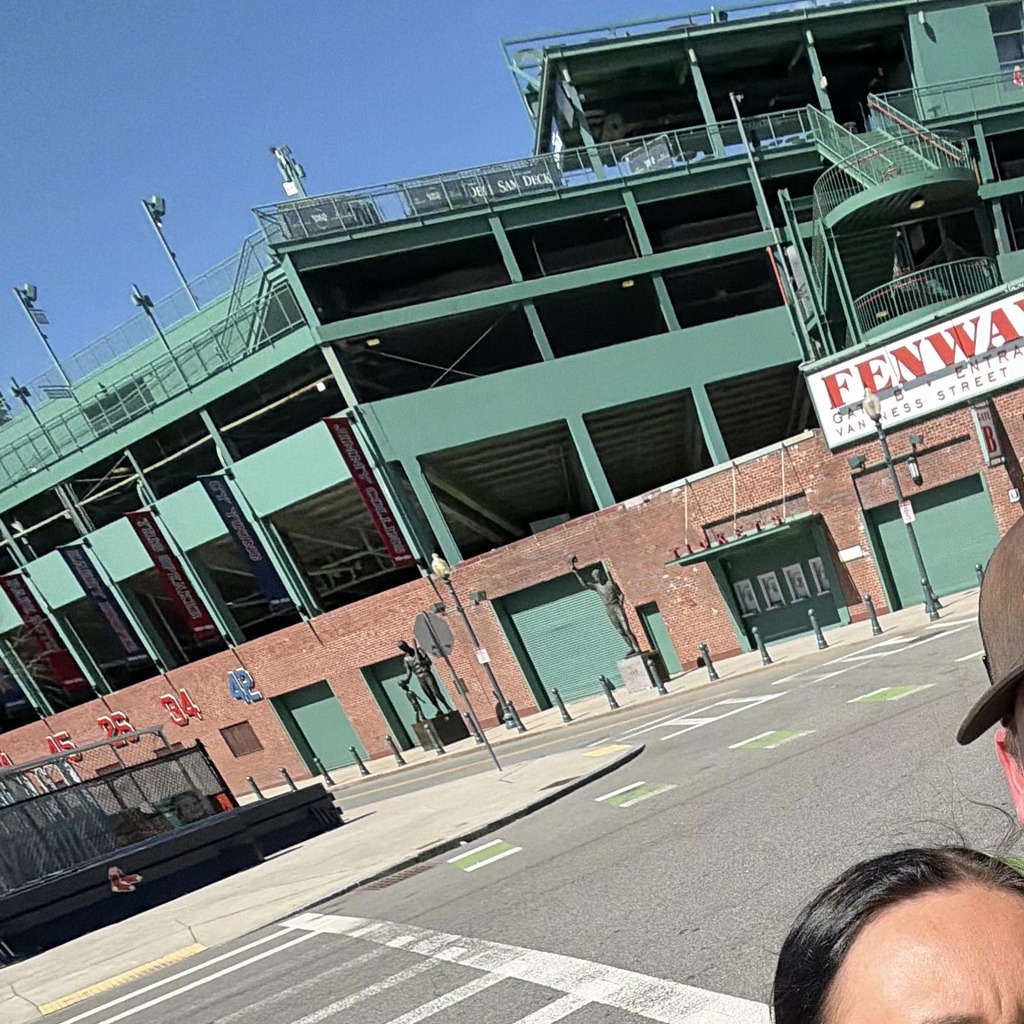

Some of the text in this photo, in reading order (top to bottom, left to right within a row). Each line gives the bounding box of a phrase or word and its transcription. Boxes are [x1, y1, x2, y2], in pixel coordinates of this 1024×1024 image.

[937, 367, 1008, 402] STREET
[982, 425, 998, 453] B
[227, 668, 263, 704] 42
[160, 688, 203, 727] 34
